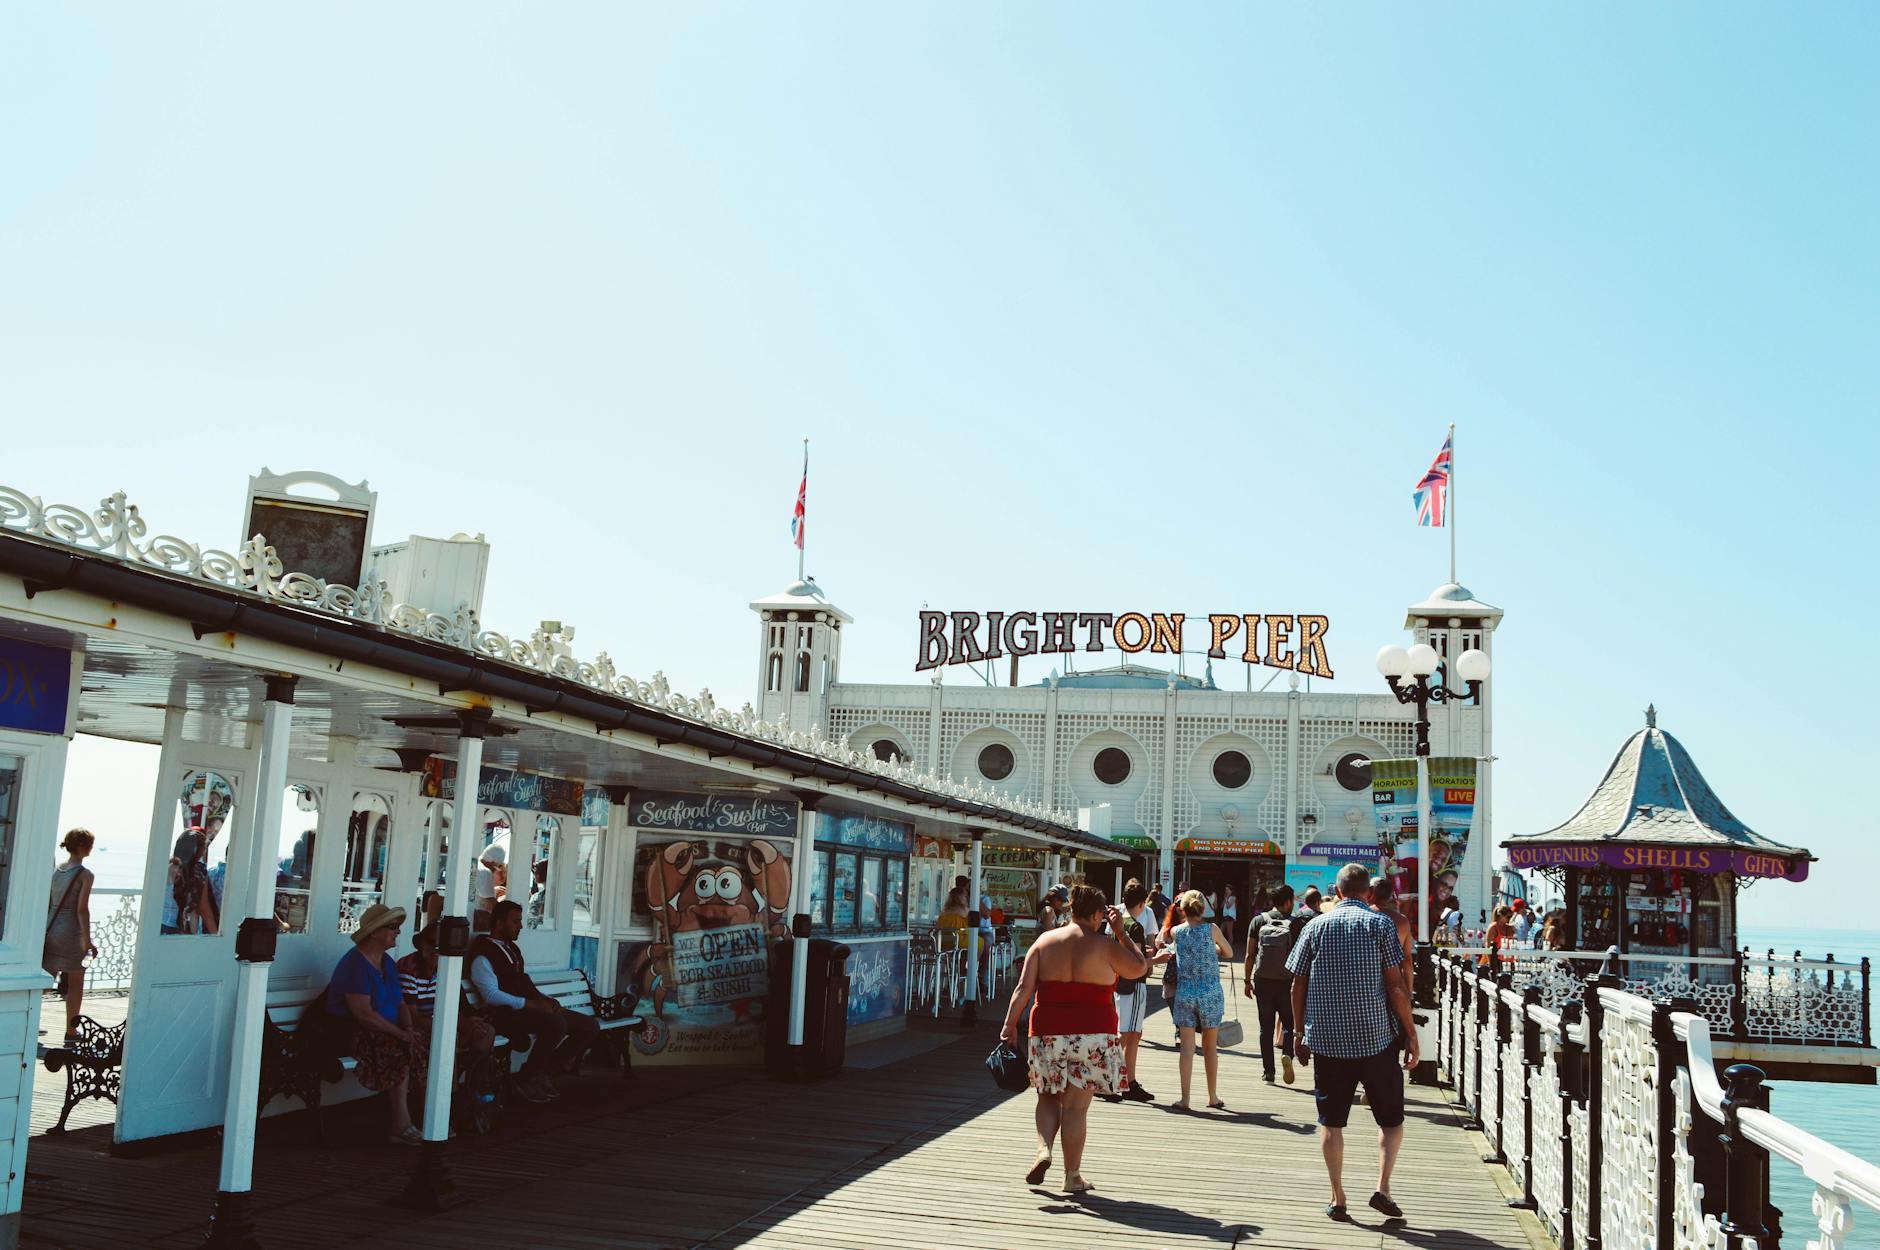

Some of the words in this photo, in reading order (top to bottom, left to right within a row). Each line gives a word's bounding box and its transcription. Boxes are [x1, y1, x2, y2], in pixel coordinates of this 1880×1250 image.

[916, 611, 1185, 672] BRIGHTON
[1208, 613, 1335, 680] PIER
[478, 769, 516, 801] eafood
[515, 776, 543, 802] Sushi
[1373, 779, 1414, 788] HORATIO'S
[1433, 777, 1475, 785] HORATIO'S
[1374, 793, 1392, 802] BAR
[1447, 791, 1473, 801] LIVE
[637, 795, 715, 827] Seafood
[716, 799, 768, 826] Sushi
[747, 821, 768, 833] Bar
[1134, 839, 1152, 848] FUN
[1511, 847, 1599, 864] SOUVENIRS
[1623, 847, 1711, 869] SHELLS
[1744, 855, 1785, 876] GIFTS
[679, 938, 696, 951] WE
[701, 928, 760, 962] OPEN
[679, 952, 700, 965] ARE
[679, 968, 704, 984] FOR
[707, 959, 766, 980] SEAFOOD
[713, 979, 752, 997] SUSHI
